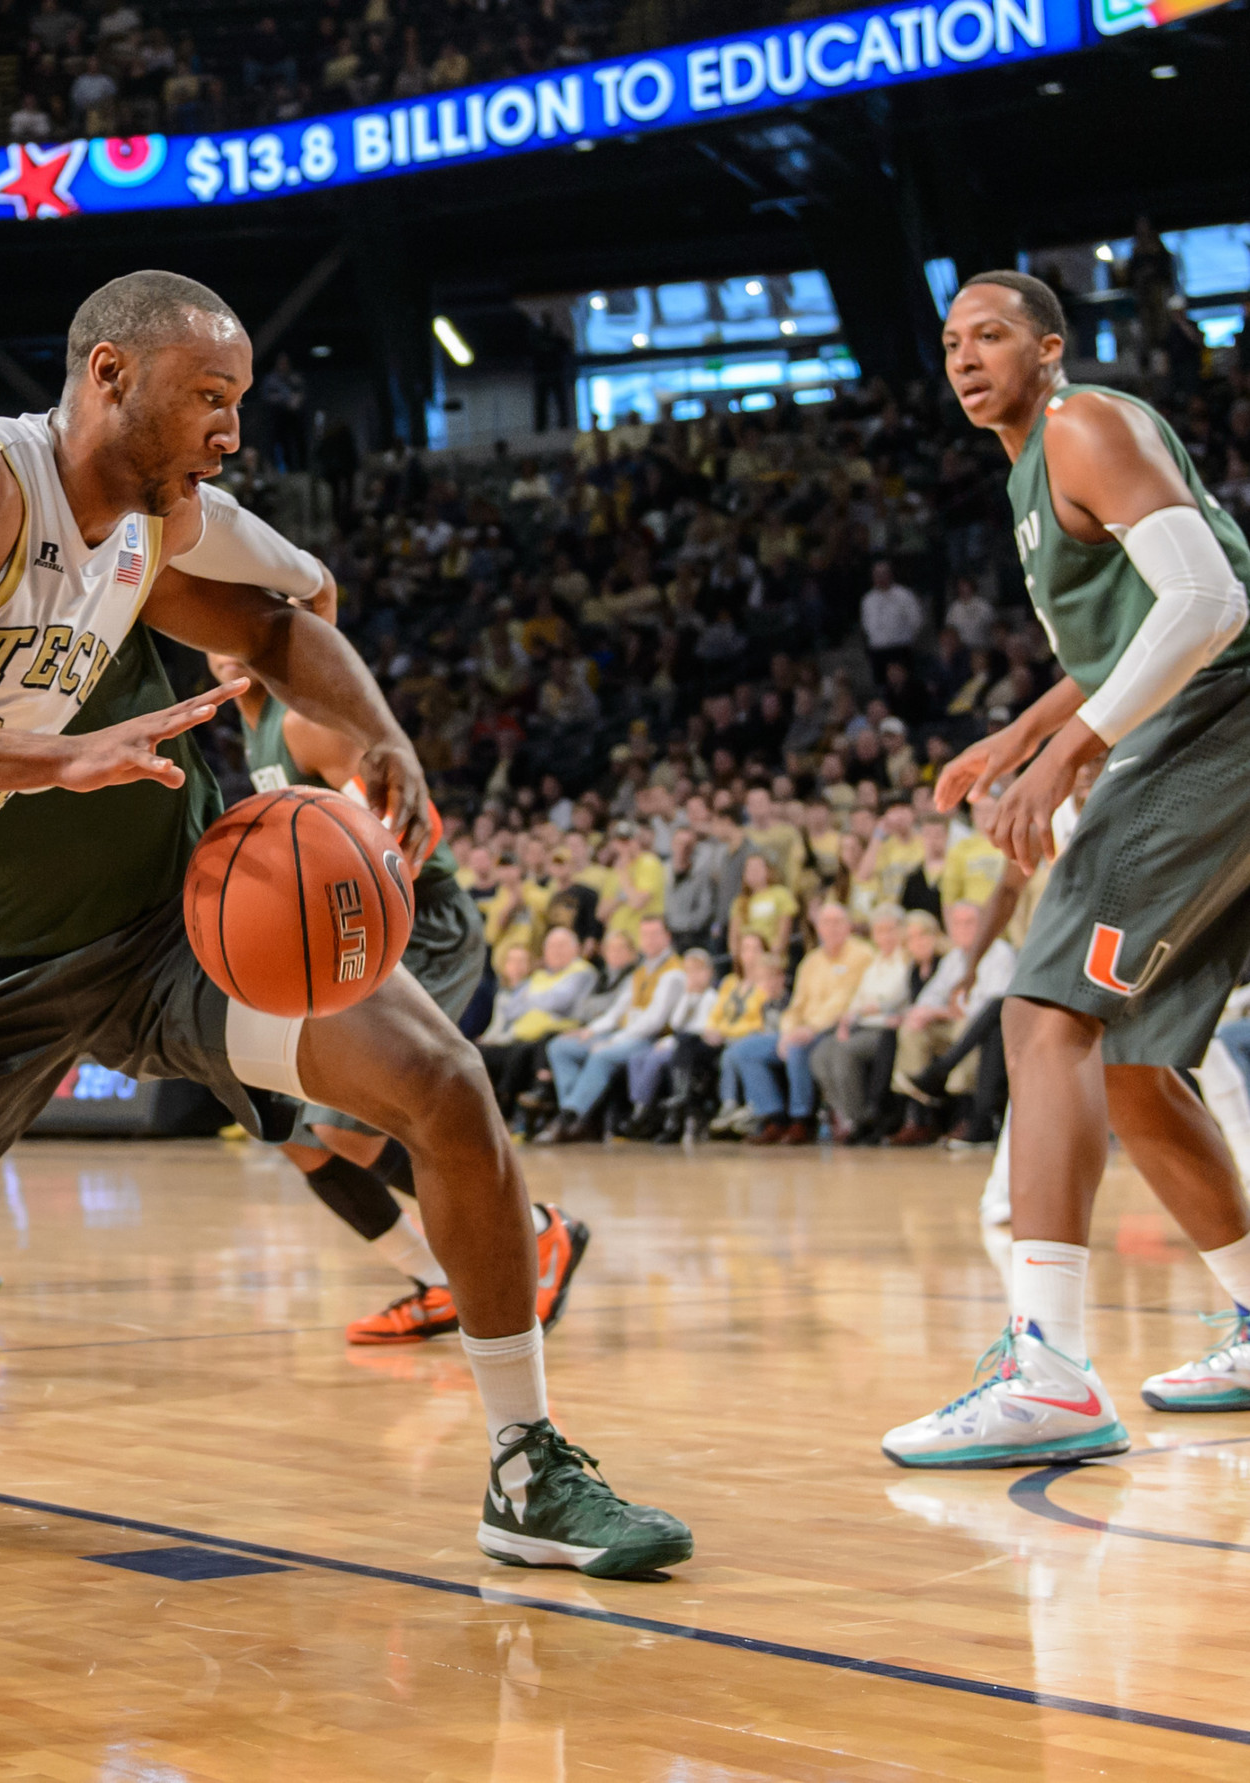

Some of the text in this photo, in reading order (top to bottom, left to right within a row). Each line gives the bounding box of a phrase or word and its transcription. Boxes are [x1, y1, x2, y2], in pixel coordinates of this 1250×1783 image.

[186, 0, 1047, 202] $13.8 BILLION TO EDUCATION
[334, 879, 366, 983] ELITE
